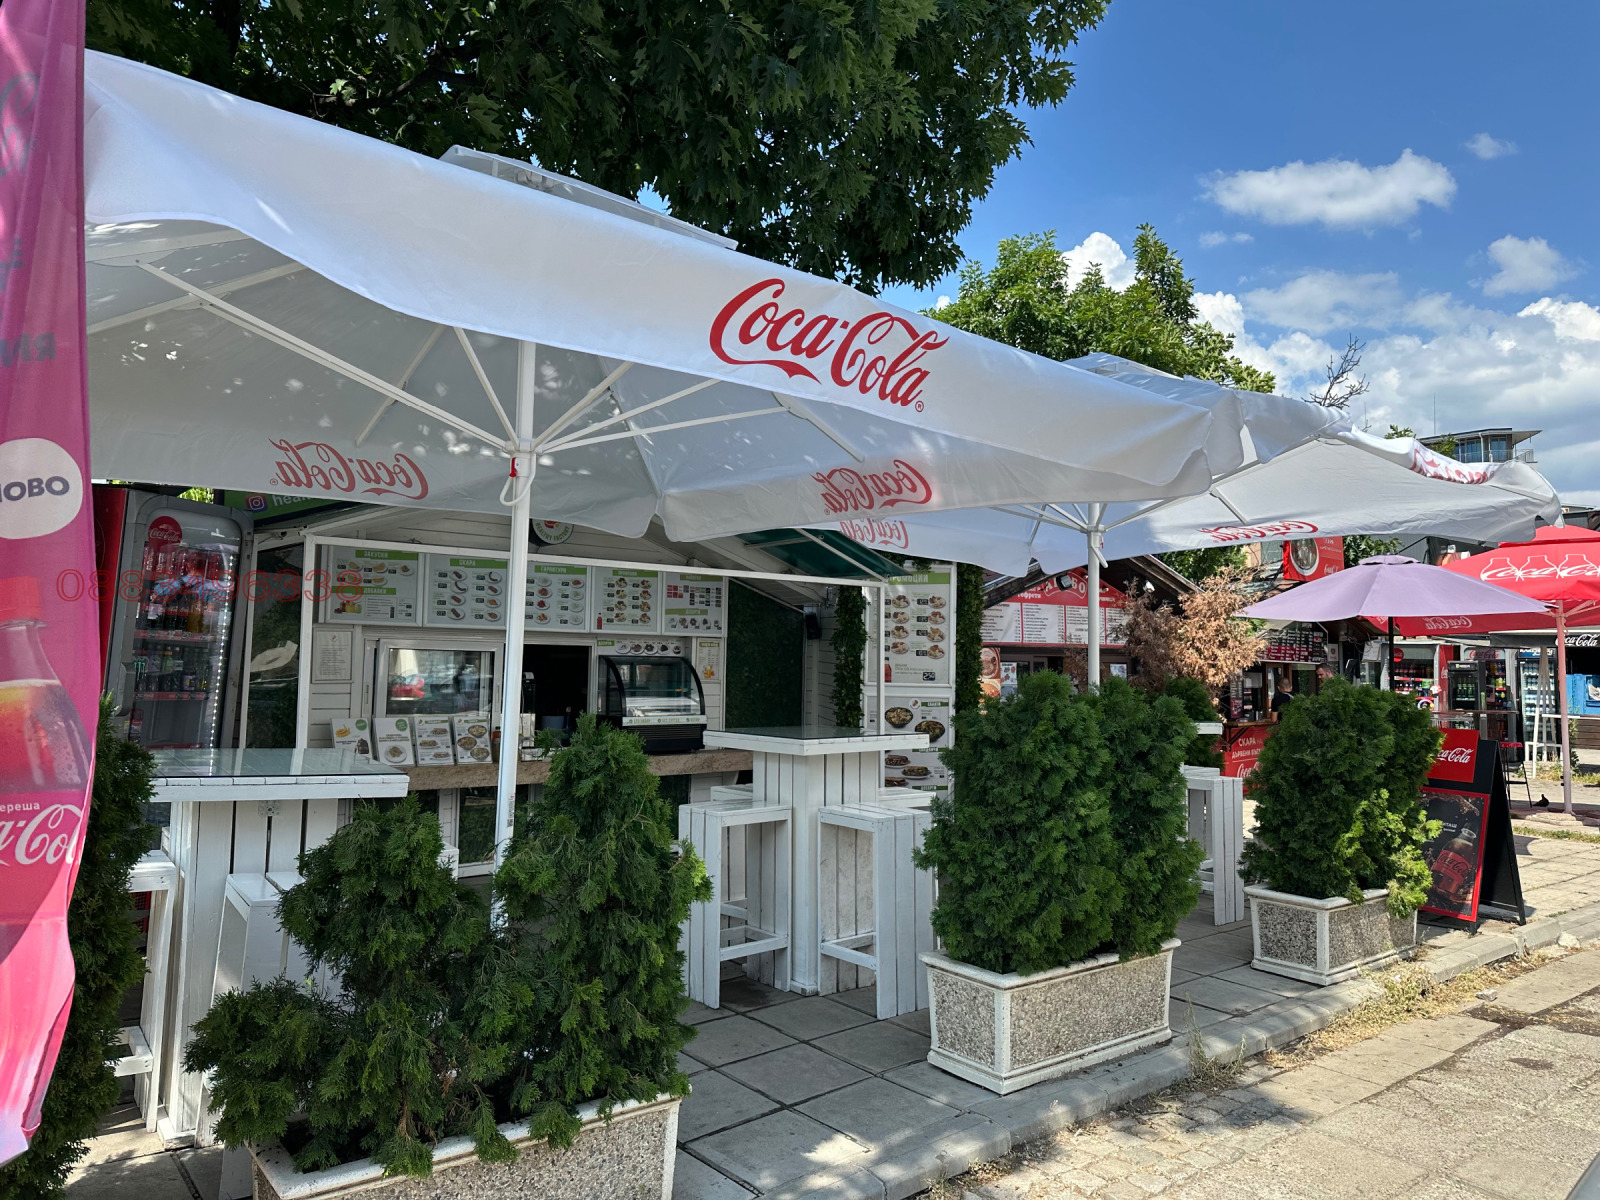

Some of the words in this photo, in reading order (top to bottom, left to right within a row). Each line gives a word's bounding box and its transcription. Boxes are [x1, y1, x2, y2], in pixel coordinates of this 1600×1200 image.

[709, 278, 950, 407] Coca-Cola
[0, 475, 70, 503] ОВО
[1238, 737, 1257, 747] СКАРА
